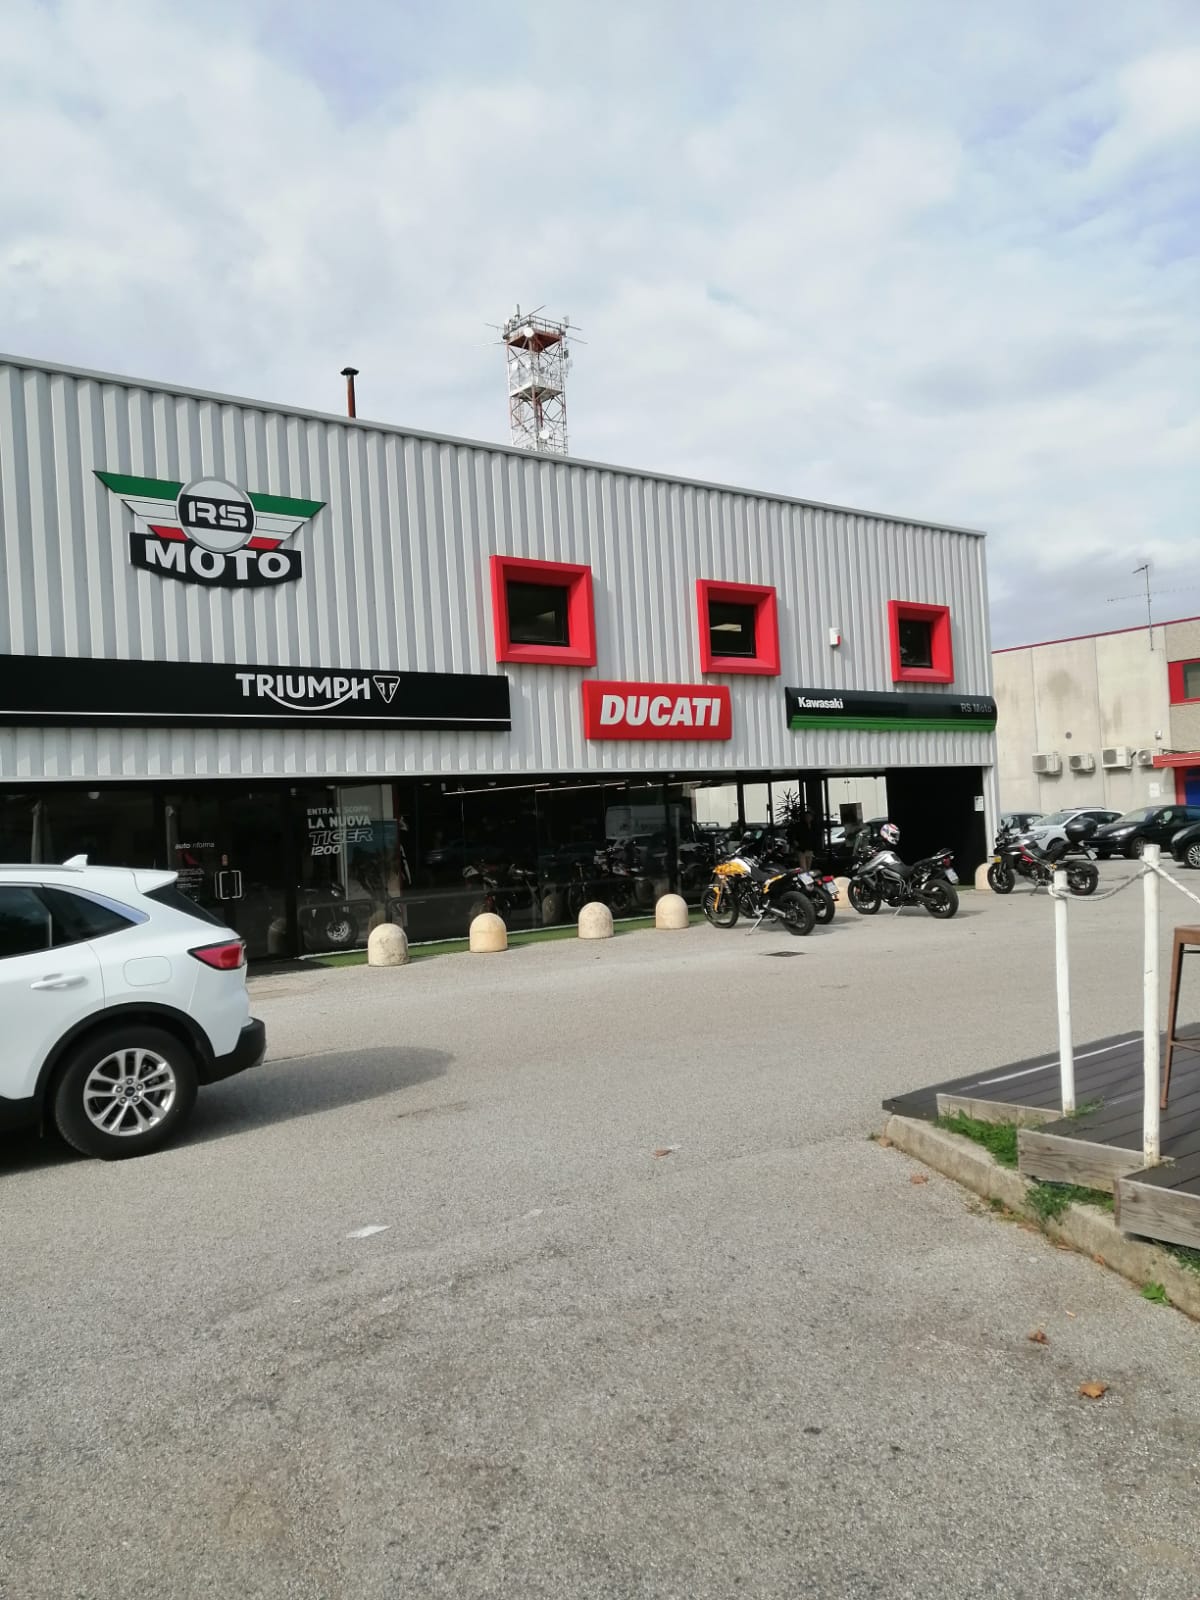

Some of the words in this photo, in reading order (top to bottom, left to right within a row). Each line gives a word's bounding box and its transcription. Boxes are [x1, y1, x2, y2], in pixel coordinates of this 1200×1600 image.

[188, 501, 248, 528] RS
[145, 539, 291, 580] MOTO
[235, 673, 371, 711] TRIUMPH
[600, 694, 721, 726] DUCATI
[797, 697, 844, 709] Kawasaki
[960, 703, 972, 713] RS
[973, 704, 992, 713] Moto
[307, 817, 325, 829] LA
[329, 815, 371, 828] NUOVA
[308, 828, 373, 846] TIGER
[311, 844, 341, 856] 1200
